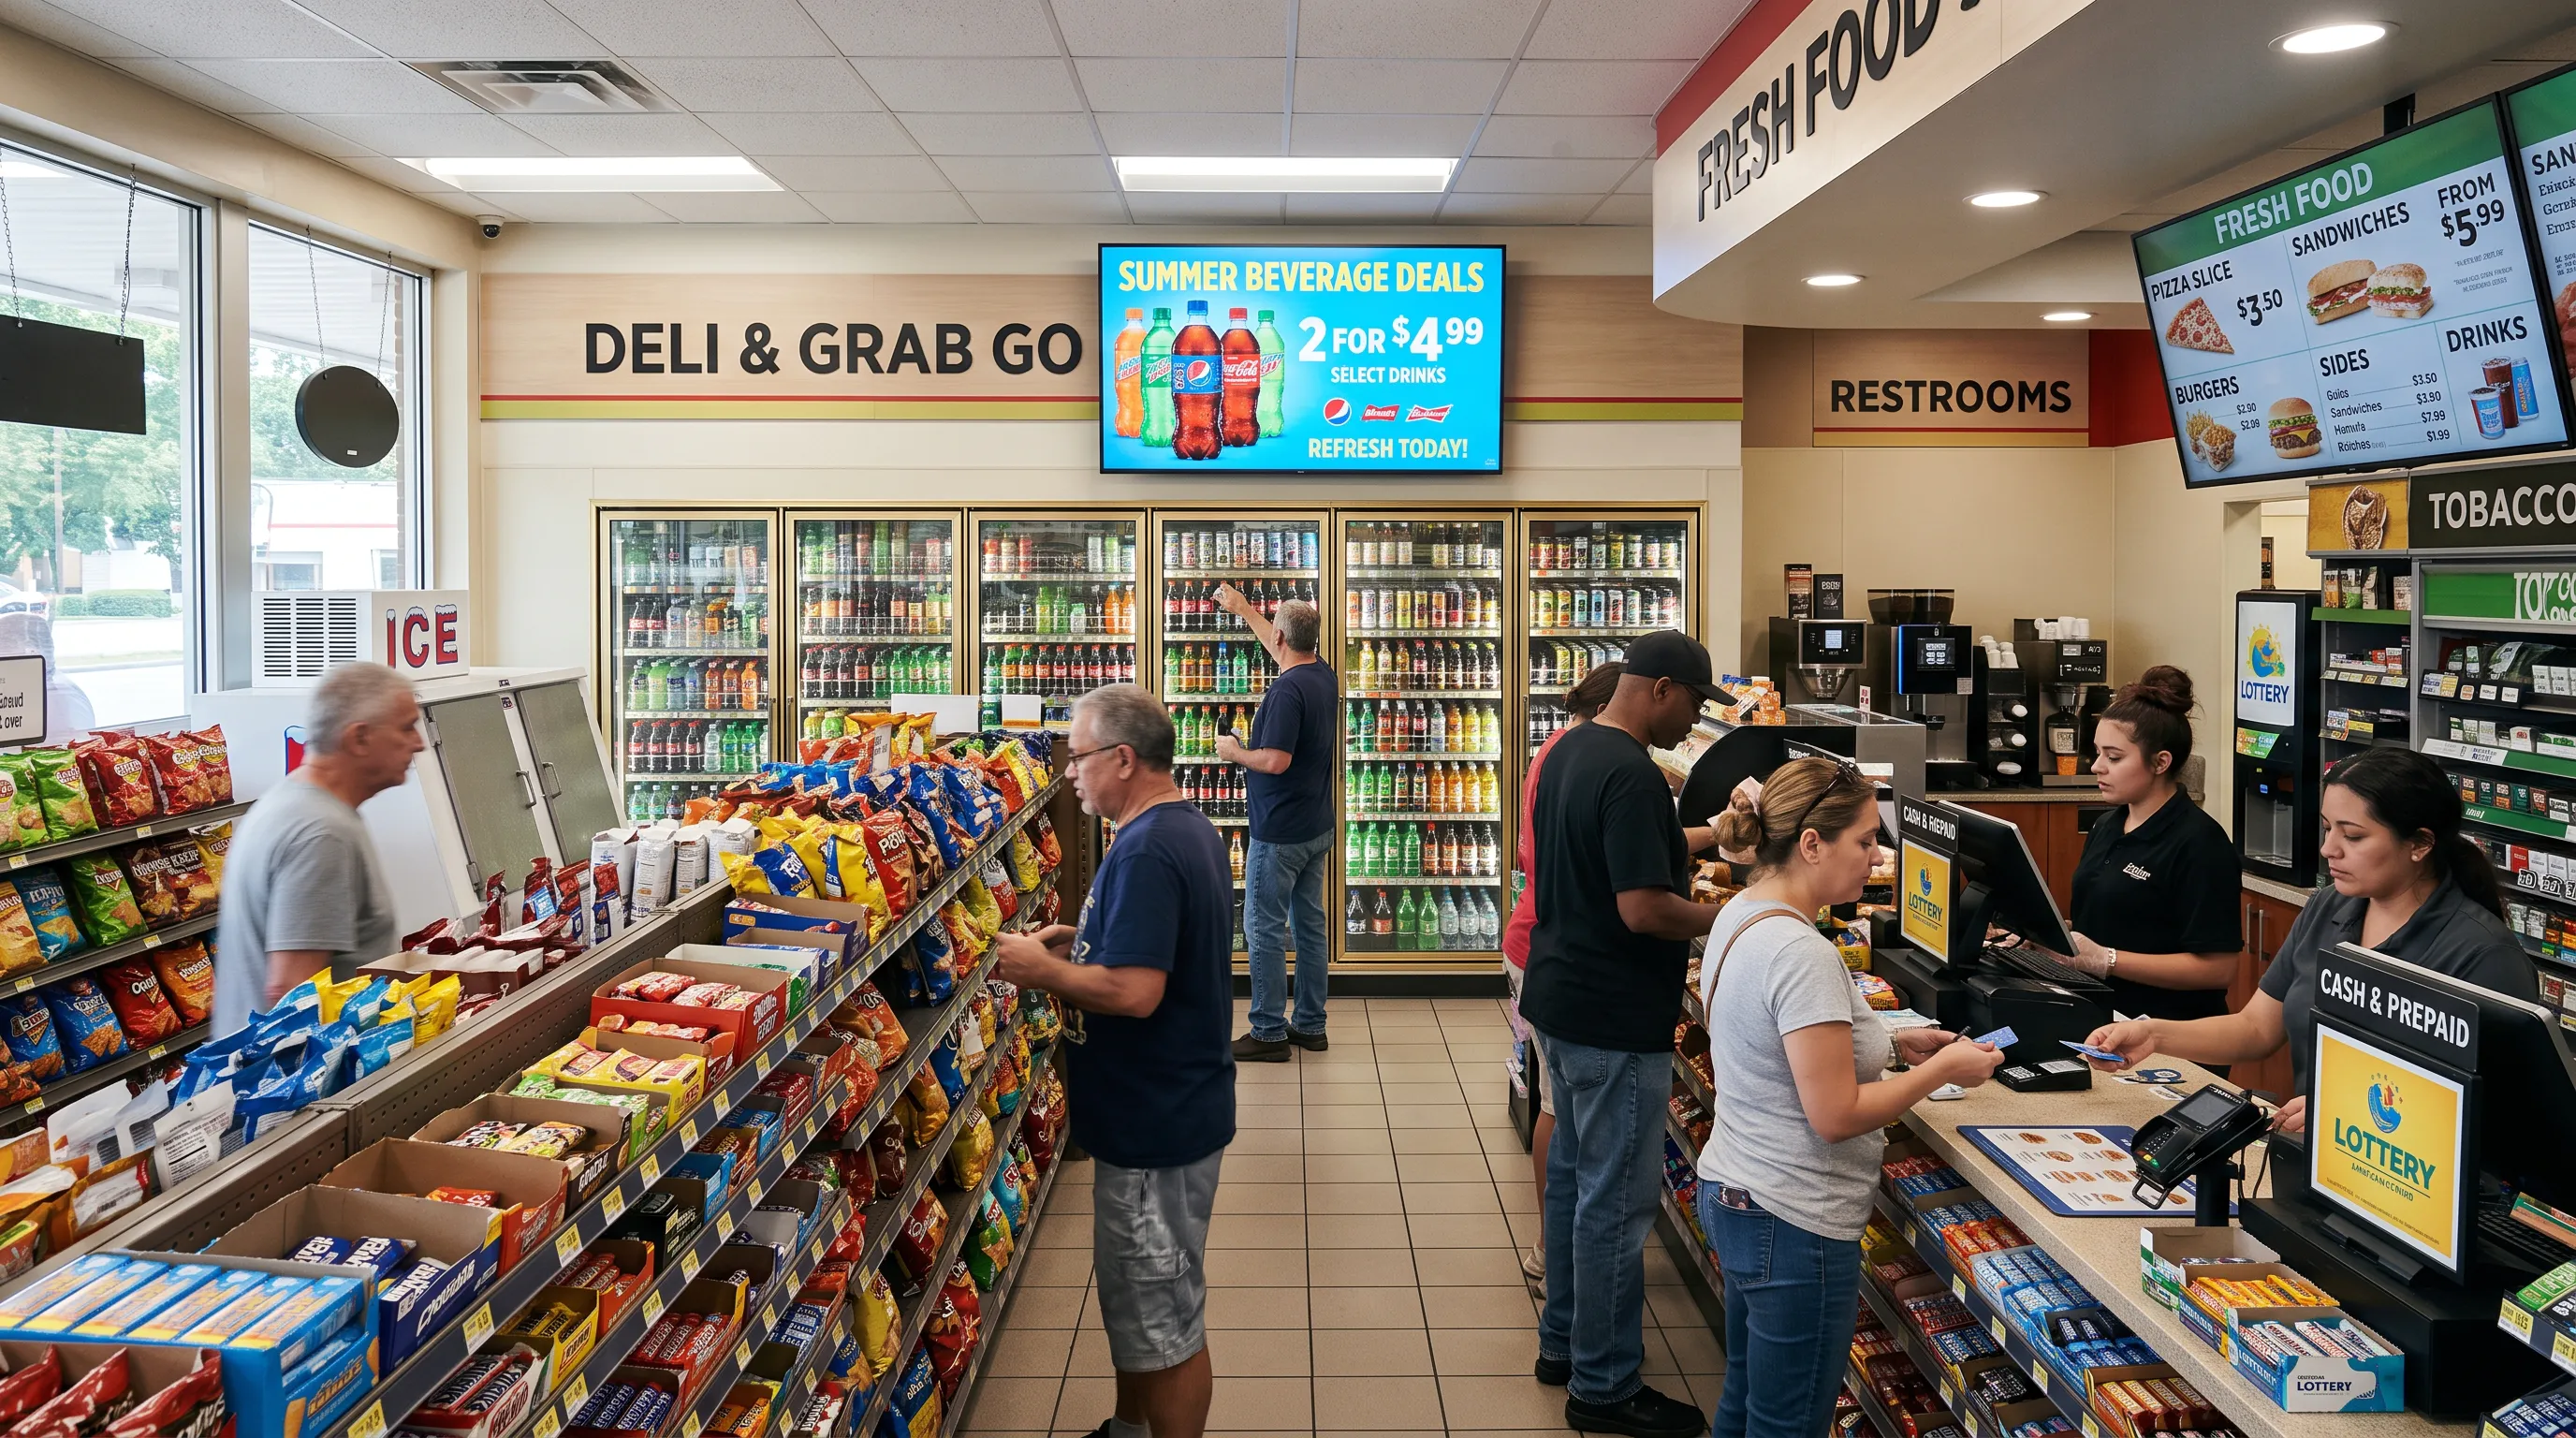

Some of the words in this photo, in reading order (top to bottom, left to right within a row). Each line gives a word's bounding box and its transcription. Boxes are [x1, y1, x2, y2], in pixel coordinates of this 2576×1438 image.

[1697, 63, 1794, 223] FRESH
[2214, 191, 2291, 244] FRESH
[2296, 162, 2374, 215] FOOD
[2437, 172, 2496, 209] FROM
[2292, 201, 2410, 257] SANDWICHES
[2440, 198, 2505, 247] $5.99
[1119, 261, 1237, 291] SUMMER
[1245, 261, 1389, 292] BEVERAGE
[1396, 262, 1485, 292] DEALS
[2151, 274, 2191, 301] PIZZA
[2191, 260, 2232, 289] SLICE
[2236, 288, 2283, 326] $3.50
[585, 322, 719, 374] DELI
[739, 321, 781, 374] &
[798, 322, 973, 374] GRAB
[992, 322, 1083, 374] GO
[1298, 316, 1326, 362] 2
[1333, 328, 1386, 354] FOR
[2446, 315, 2527, 352] DRINKS
[1330, 366, 1385, 384] SELECT
[1390, 366, 1447, 384] DRINKS
[2320, 348, 2370, 376] SIDES
[2412, 373, 2437, 386] $3.50
[1831, 379, 2072, 414] RESTROOMS
[2175, 375, 2240, 404] BURGERS
[2330, 401, 2383, 418] Sandwiches
[2421, 409, 2446, 424] $7.99
[1309, 437, 1394, 458] REFRESH
[1398, 438, 1468, 459] TODAY!
[2426, 429, 2451, 443] $1.99
[2428, 483, 2576, 529] TOBACCO
[386, 603, 459, 668] ICE
[2241, 680, 2290, 704] LOTTERY
[5, 715, 22, 729] over
[1909, 891, 1943, 922] LOTTERY
[2320, 968, 2365, 1008] CASH
[2369, 986, 2382, 1014] &
[2387, 992, 2470, 1049] PREPAID
[2334, 1117, 2437, 1191] LOTTERY
[2297, 1381, 2352, 1391] LOTTERY
